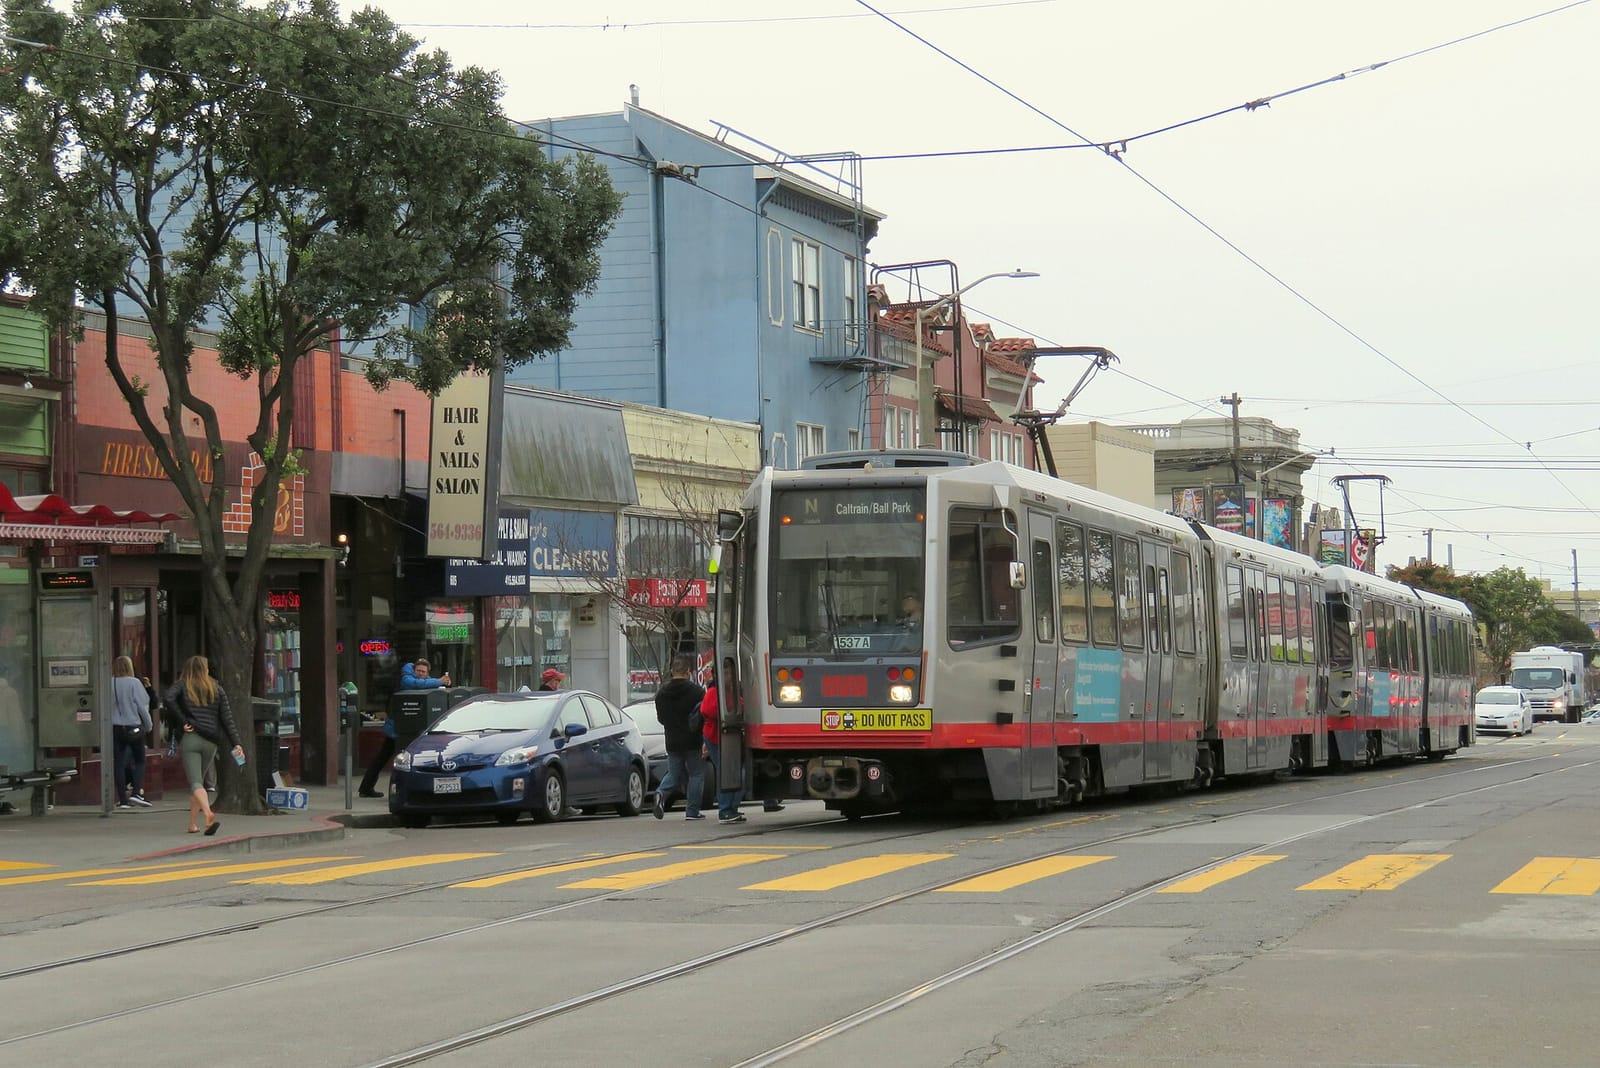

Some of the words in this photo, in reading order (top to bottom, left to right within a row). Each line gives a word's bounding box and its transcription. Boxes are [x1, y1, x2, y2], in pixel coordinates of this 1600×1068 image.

[443, 407, 479, 424] HAIR
[454, 429, 465, 446] &
[439, 451, 480, 469] NAILS
[435, 477, 481, 495] SALON
[805, 499, 818, 513] N
[892, 501, 911, 513] Park
[513, 517, 528, 540] SALON
[506, 550, 527, 567] WAXING
[532, 546, 609, 573] CLEANERS
[360, 643, 390, 653] OPEN
[825, 714, 840, 727] STOP
[861, 713, 875, 727] DO
[878, 713, 897, 727] NOT
[900, 713, 925, 727] PASS
